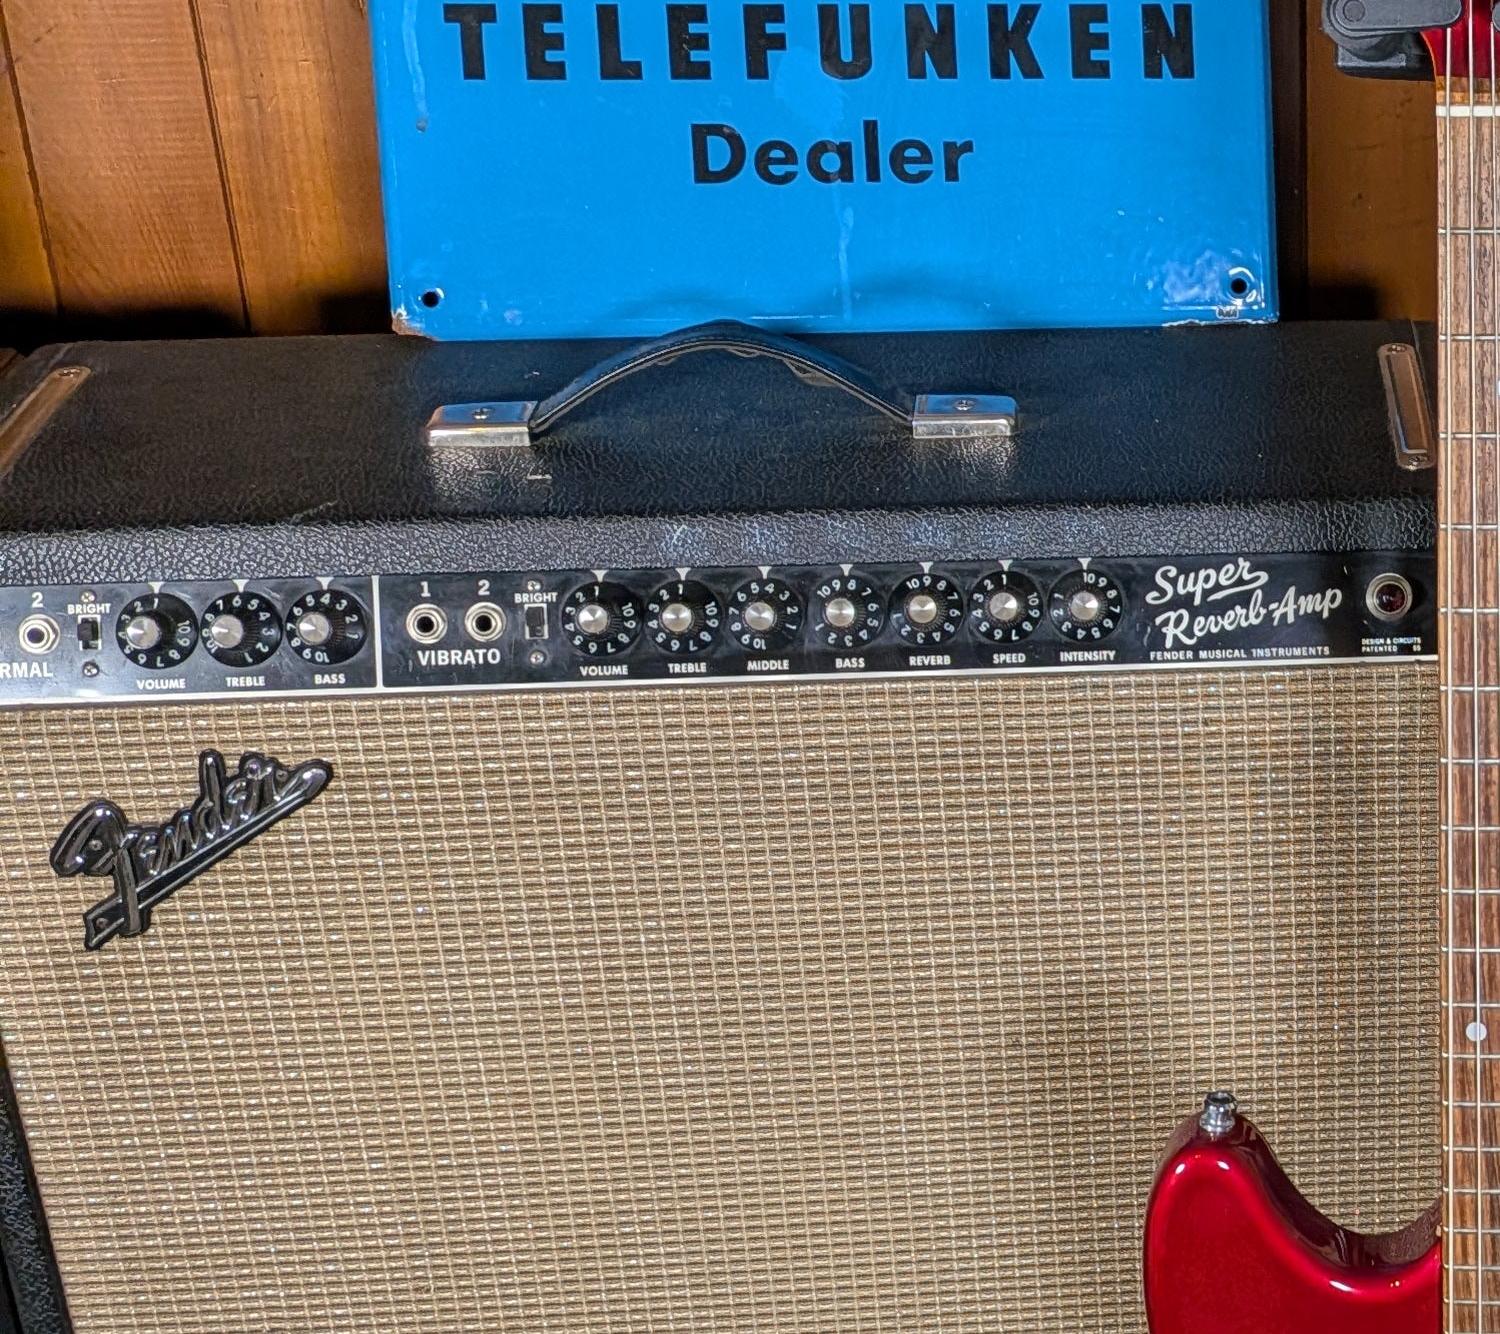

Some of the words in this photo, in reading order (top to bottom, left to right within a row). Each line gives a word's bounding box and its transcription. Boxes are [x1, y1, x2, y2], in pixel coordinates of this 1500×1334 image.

[443, 3, 1196, 81] TELEFUNKEN
[690, 119, 975, 185] Dealer
[906, 578, 919, 589] 10
[923, 575, 931, 586] 9
[937, 580, 946, 590] 8
[1001, 574, 1007, 585] 1
[1083, 573, 1095, 584] 10
[1098, 577, 1107, 587] 9
[1145, 557, 1269, 606] Super
[420, 581, 431, 597] 1
[478, 580, 490, 595] 2
[678, 584, 683, 594] 1
[984, 579, 994, 590] 2
[594, 586, 599, 597] 1
[660, 589, 669, 600] 2
[737, 591, 746, 602] 6
[751, 582, 759, 593] 5
[765, 583, 774, 594] 4
[779, 591, 790, 601] 3
[817, 585, 831, 598] 10
[832, 579, 840, 590] 9
[848, 579, 856, 590] 8
[868, 603, 879, 611] 6
[1107, 589, 1117, 598] 8
[32, 592, 43, 608] 2
[153, 598, 158, 608] 1
[305, 595, 315, 606] 5
[320, 593, 330, 604] 4
[514, 592, 558, 603] BRIGHT
[576, 592, 585, 603] 2
[973, 593, 984, 602] 3
[68, 603, 111, 614] BRIGHT
[134, 601, 143, 612] 2
[216, 600, 224, 610] 7
[232, 595, 242, 606] 6
[247, 599, 259, 610] 5
[259, 612, 270, 621] 4
[336, 599, 347, 610] 3
[649, 603, 659, 612] 3
[1110, 605, 1120, 613] 7
[565, 607, 575, 615] 3
[972, 609, 983, 618] 4
[1155, 586, 1343, 649] Reverb-Amp
[589, 642, 597, 653] 6
[671, 640, 680, 651] 6
[138, 653, 146, 663] 6
[169, 649, 180, 660] 8
[315, 651, 329, 662] 10
[418, 648, 501, 666] VIBRATO
[993, 653, 1026, 664] SPEED
[1060, 650, 1116, 662] INTENSITY
[1150, 650, 1193, 661] FENDER
[1199, 649, 1247, 659] MUSICAL
[1251, 646, 1330, 658] INSTRUMENTS
[747, 659, 789, 671] MIDDLE
[835, 658, 865, 668] BASS
[909, 655, 951, 666] REVERB
[580, 665, 628, 676] VOLUME
[668, 662, 707, 673] TREBLE
[137, 679, 186, 690] VOLUME
[226, 676, 265, 686] TREBLE
[314, 674, 345, 684] BASS
[50, 748, 333, 950] Fender
